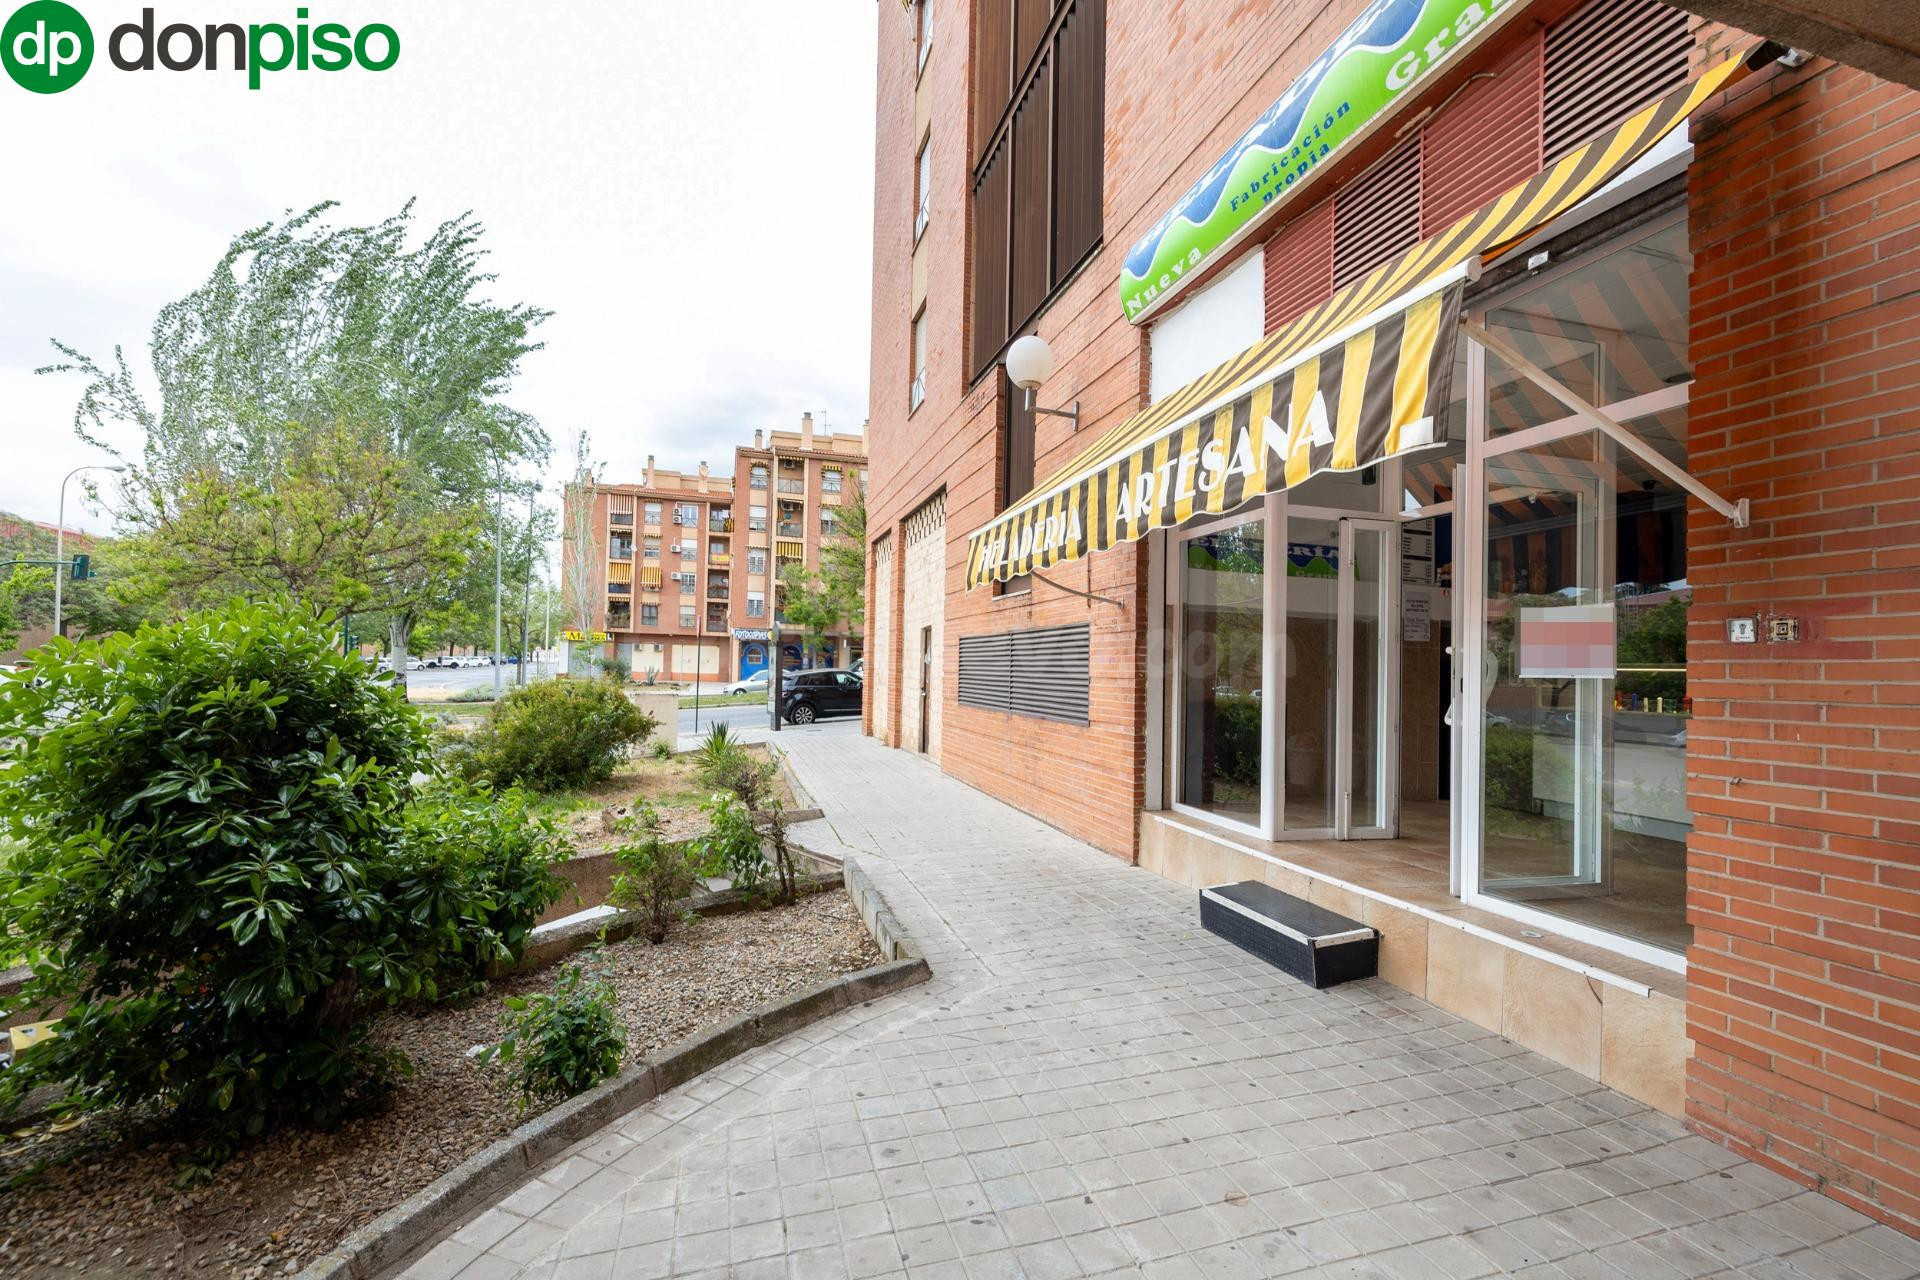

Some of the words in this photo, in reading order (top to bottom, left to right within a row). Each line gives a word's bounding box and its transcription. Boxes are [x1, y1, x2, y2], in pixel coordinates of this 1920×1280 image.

[1385, 0, 1511, 91] Gra
[1230, 101, 1351, 212] Fabricación
[1262, 143, 1330, 204] propia
[1127, 247, 1202, 316] Nueva
[1114, 390, 1335, 526] ARTESANA
